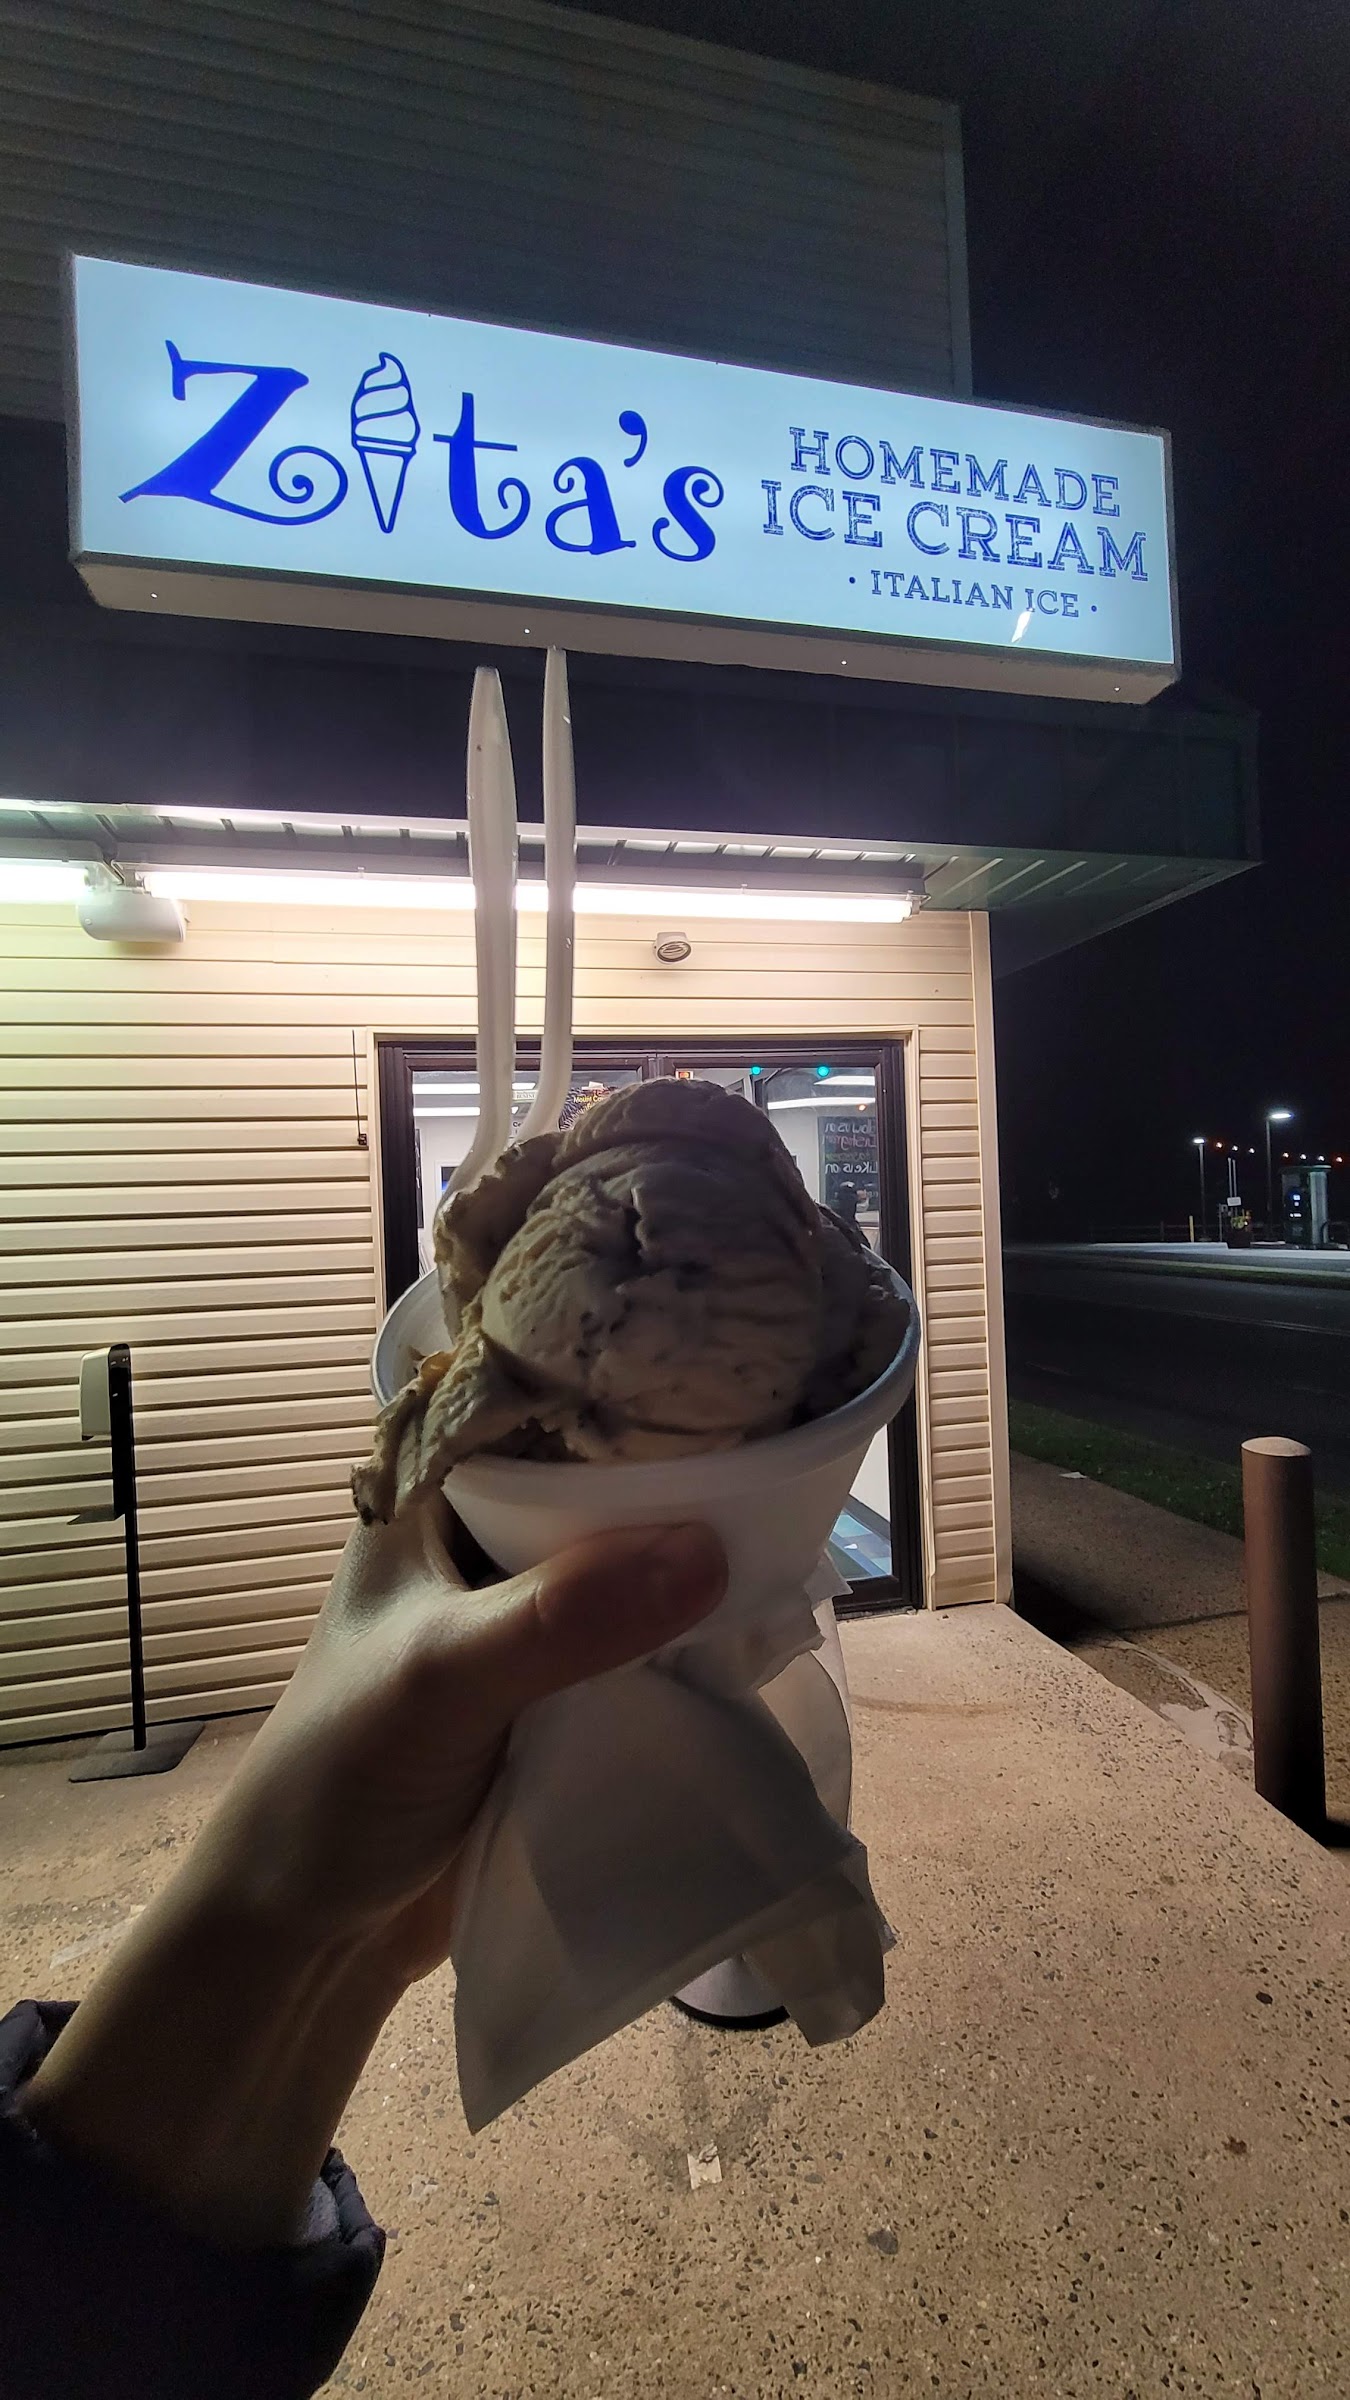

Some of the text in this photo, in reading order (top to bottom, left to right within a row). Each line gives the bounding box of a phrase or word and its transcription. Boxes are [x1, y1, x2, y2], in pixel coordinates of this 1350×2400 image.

[789, 427, 1120, 517] HOMEMADE
[761, 480, 1149, 582] ICE CREAM
[871, 570, 1079, 617] ITALIAN ICE
